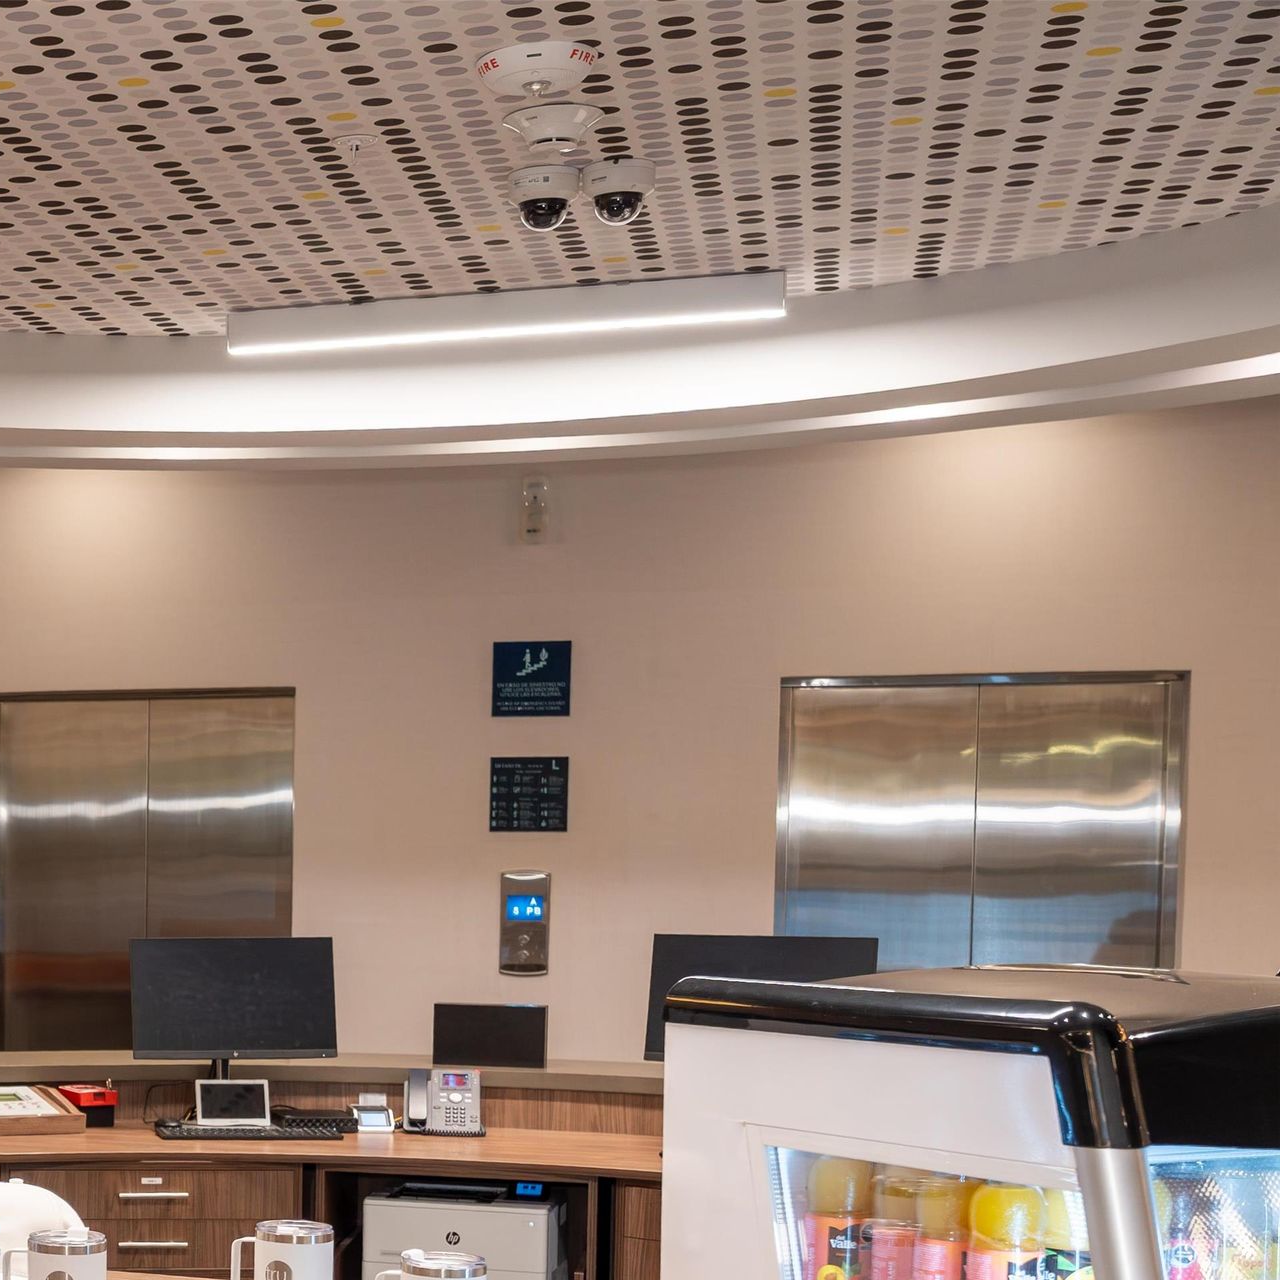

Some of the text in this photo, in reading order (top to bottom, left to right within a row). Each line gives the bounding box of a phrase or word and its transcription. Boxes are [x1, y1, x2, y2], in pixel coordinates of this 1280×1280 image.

[570, 48, 595, 65] FIRE
[478, 58, 500, 79] FIRE
[446, 1231, 460, 1246] hp
[829, 1238, 858, 1249] Valle
